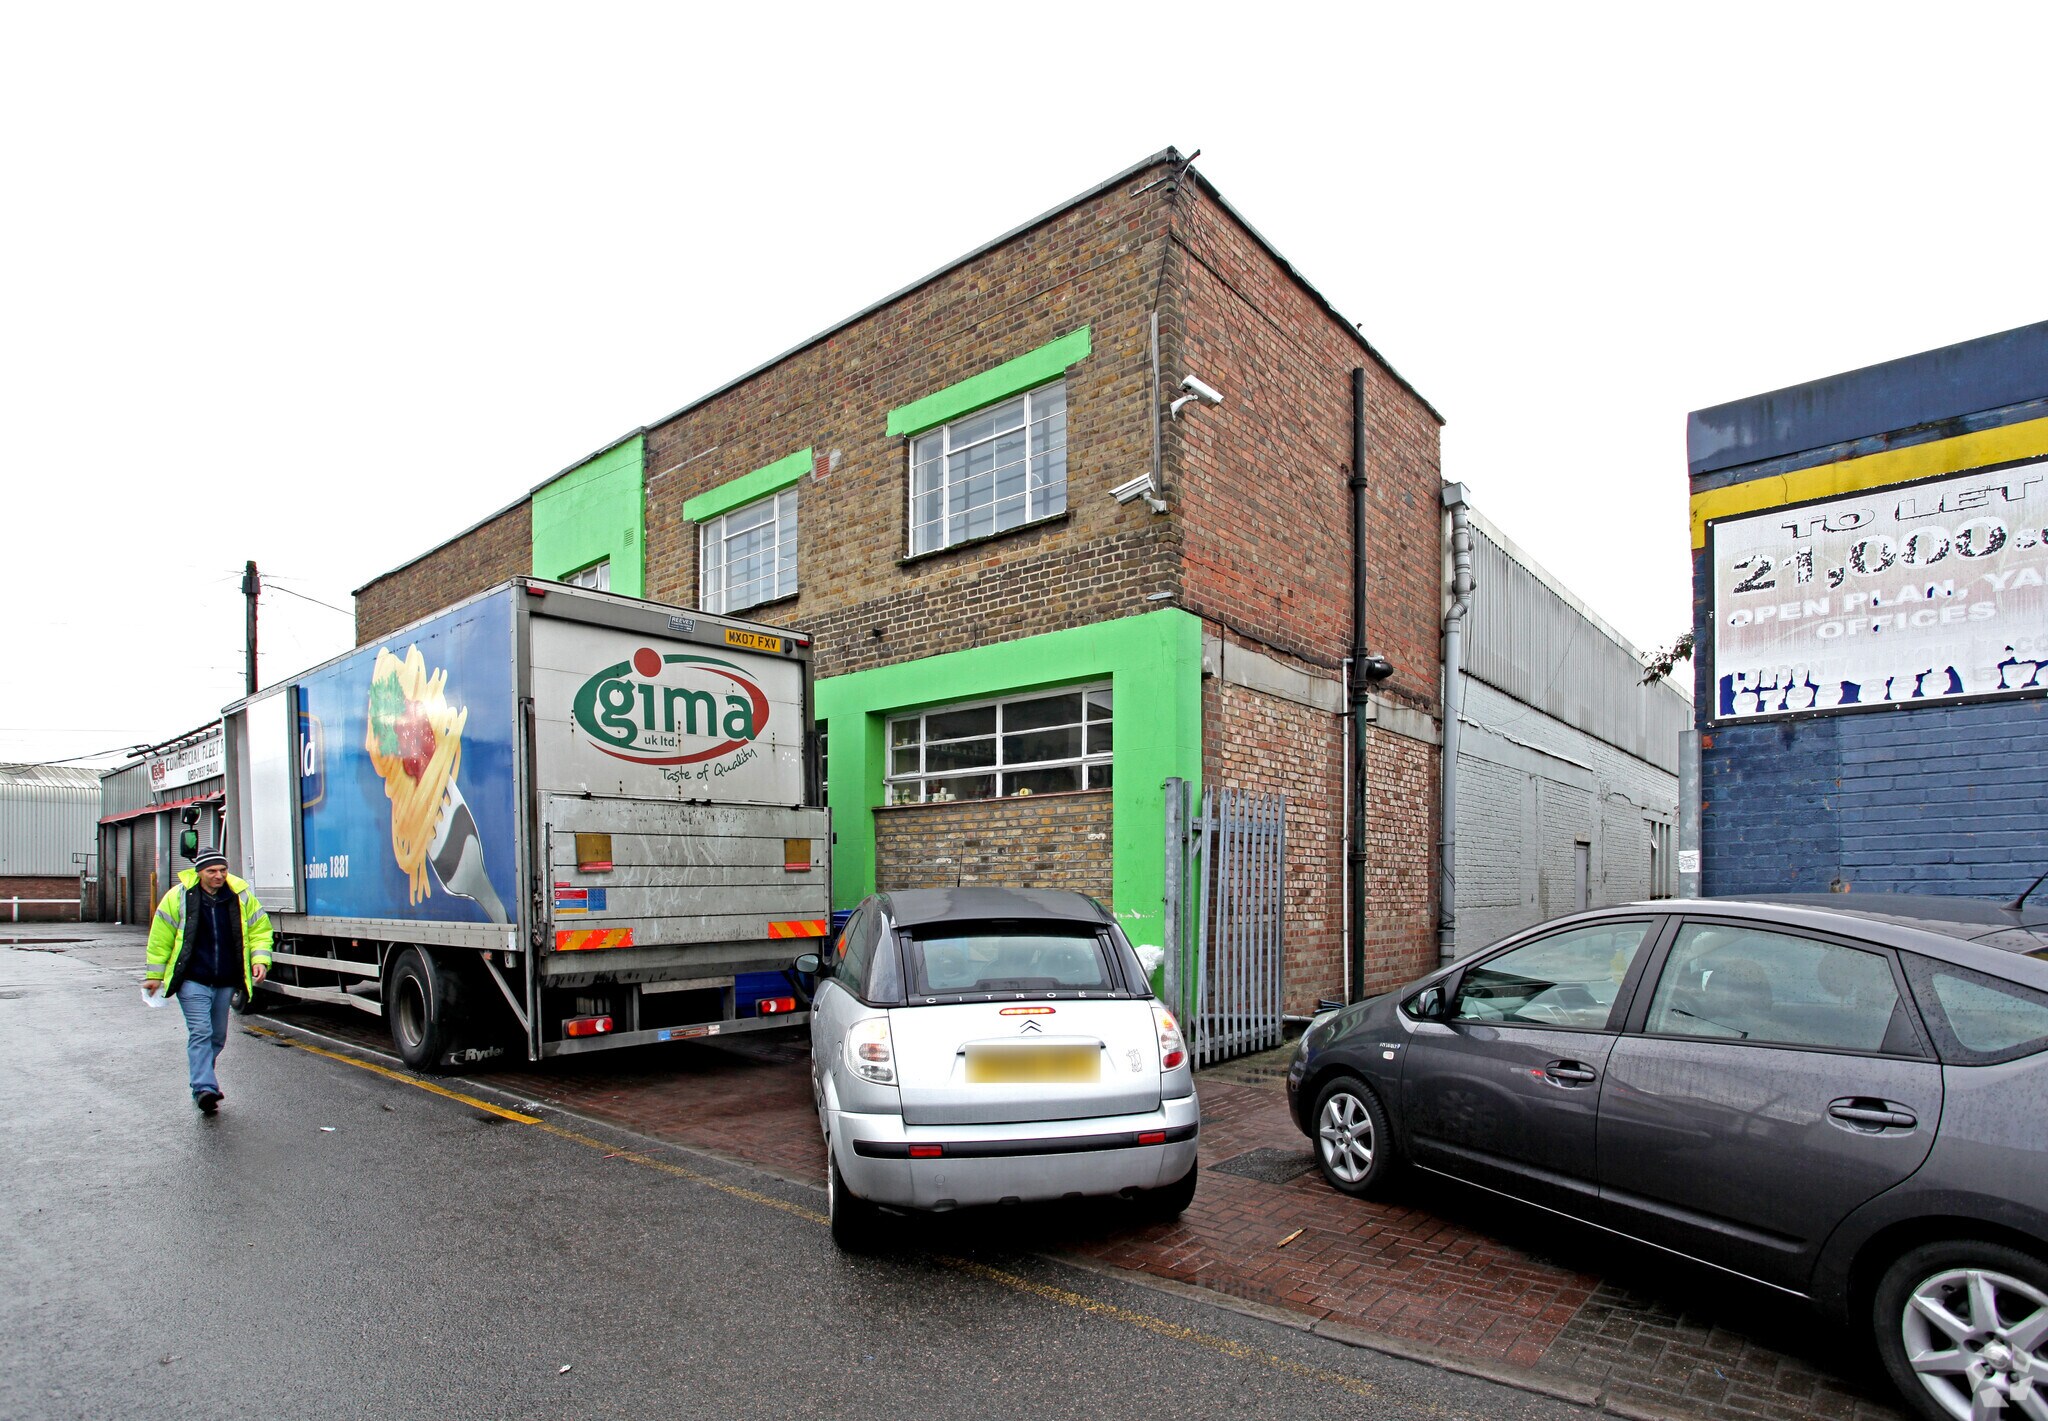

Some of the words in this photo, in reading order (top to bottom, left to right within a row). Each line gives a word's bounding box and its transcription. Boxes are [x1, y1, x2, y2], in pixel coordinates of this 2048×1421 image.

[1781, 507, 1876, 538] TO
[1895, 475, 2043, 521] LET
[1727, 597, 1830, 628] OPEN
[1844, 579, 1969, 613] PLAN,
[1983, 567, 2048, 592] YA
[1816, 601, 1997, 639] OFFICES
[728, 631, 754, 645] MX07
[758, 637, 777, 649] FXV
[598, 648, 756, 746] gima
[203, 739, 219, 760] FLEET
[644, 736, 658, 746] uk
[660, 736, 678, 748] ltd.
[658, 767, 692, 782] Taste
[696, 764, 709, 780] of
[713, 748, 758, 777] Quality
[309, 856, 328, 879] since
[330, 854, 349, 878] 1881
